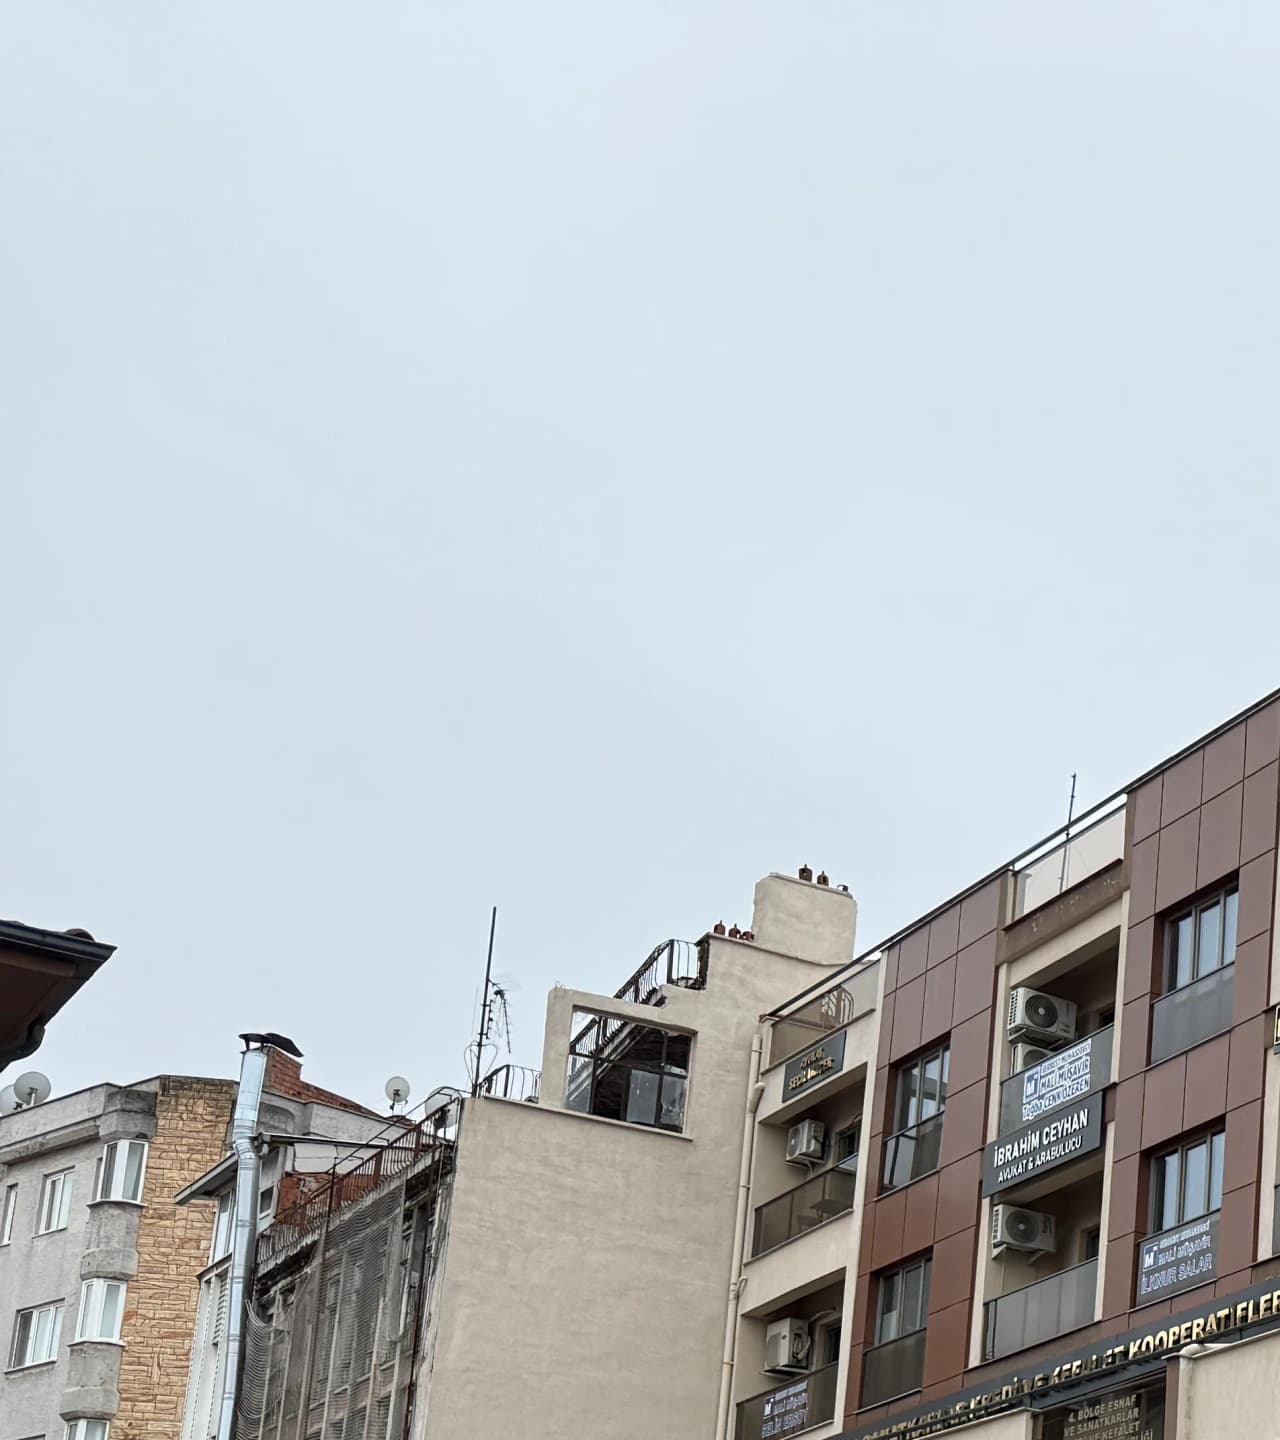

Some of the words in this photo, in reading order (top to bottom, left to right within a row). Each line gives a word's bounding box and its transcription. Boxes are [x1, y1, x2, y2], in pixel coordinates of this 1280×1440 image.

[993, 1130, 1040, 1168] İBRAHİM
[1042, 1108, 1089, 1146] CEYHAN
[998, 1161, 1026, 1184] AVUKAT
[1034, 1135, 1082, 1167] ARABULUCU
[1063, 1425, 1076, 1438] VE
[1077, 1407, 1139, 1435] SANATKARLAR
[1102, 1421, 1140, 1440] KEFALET
